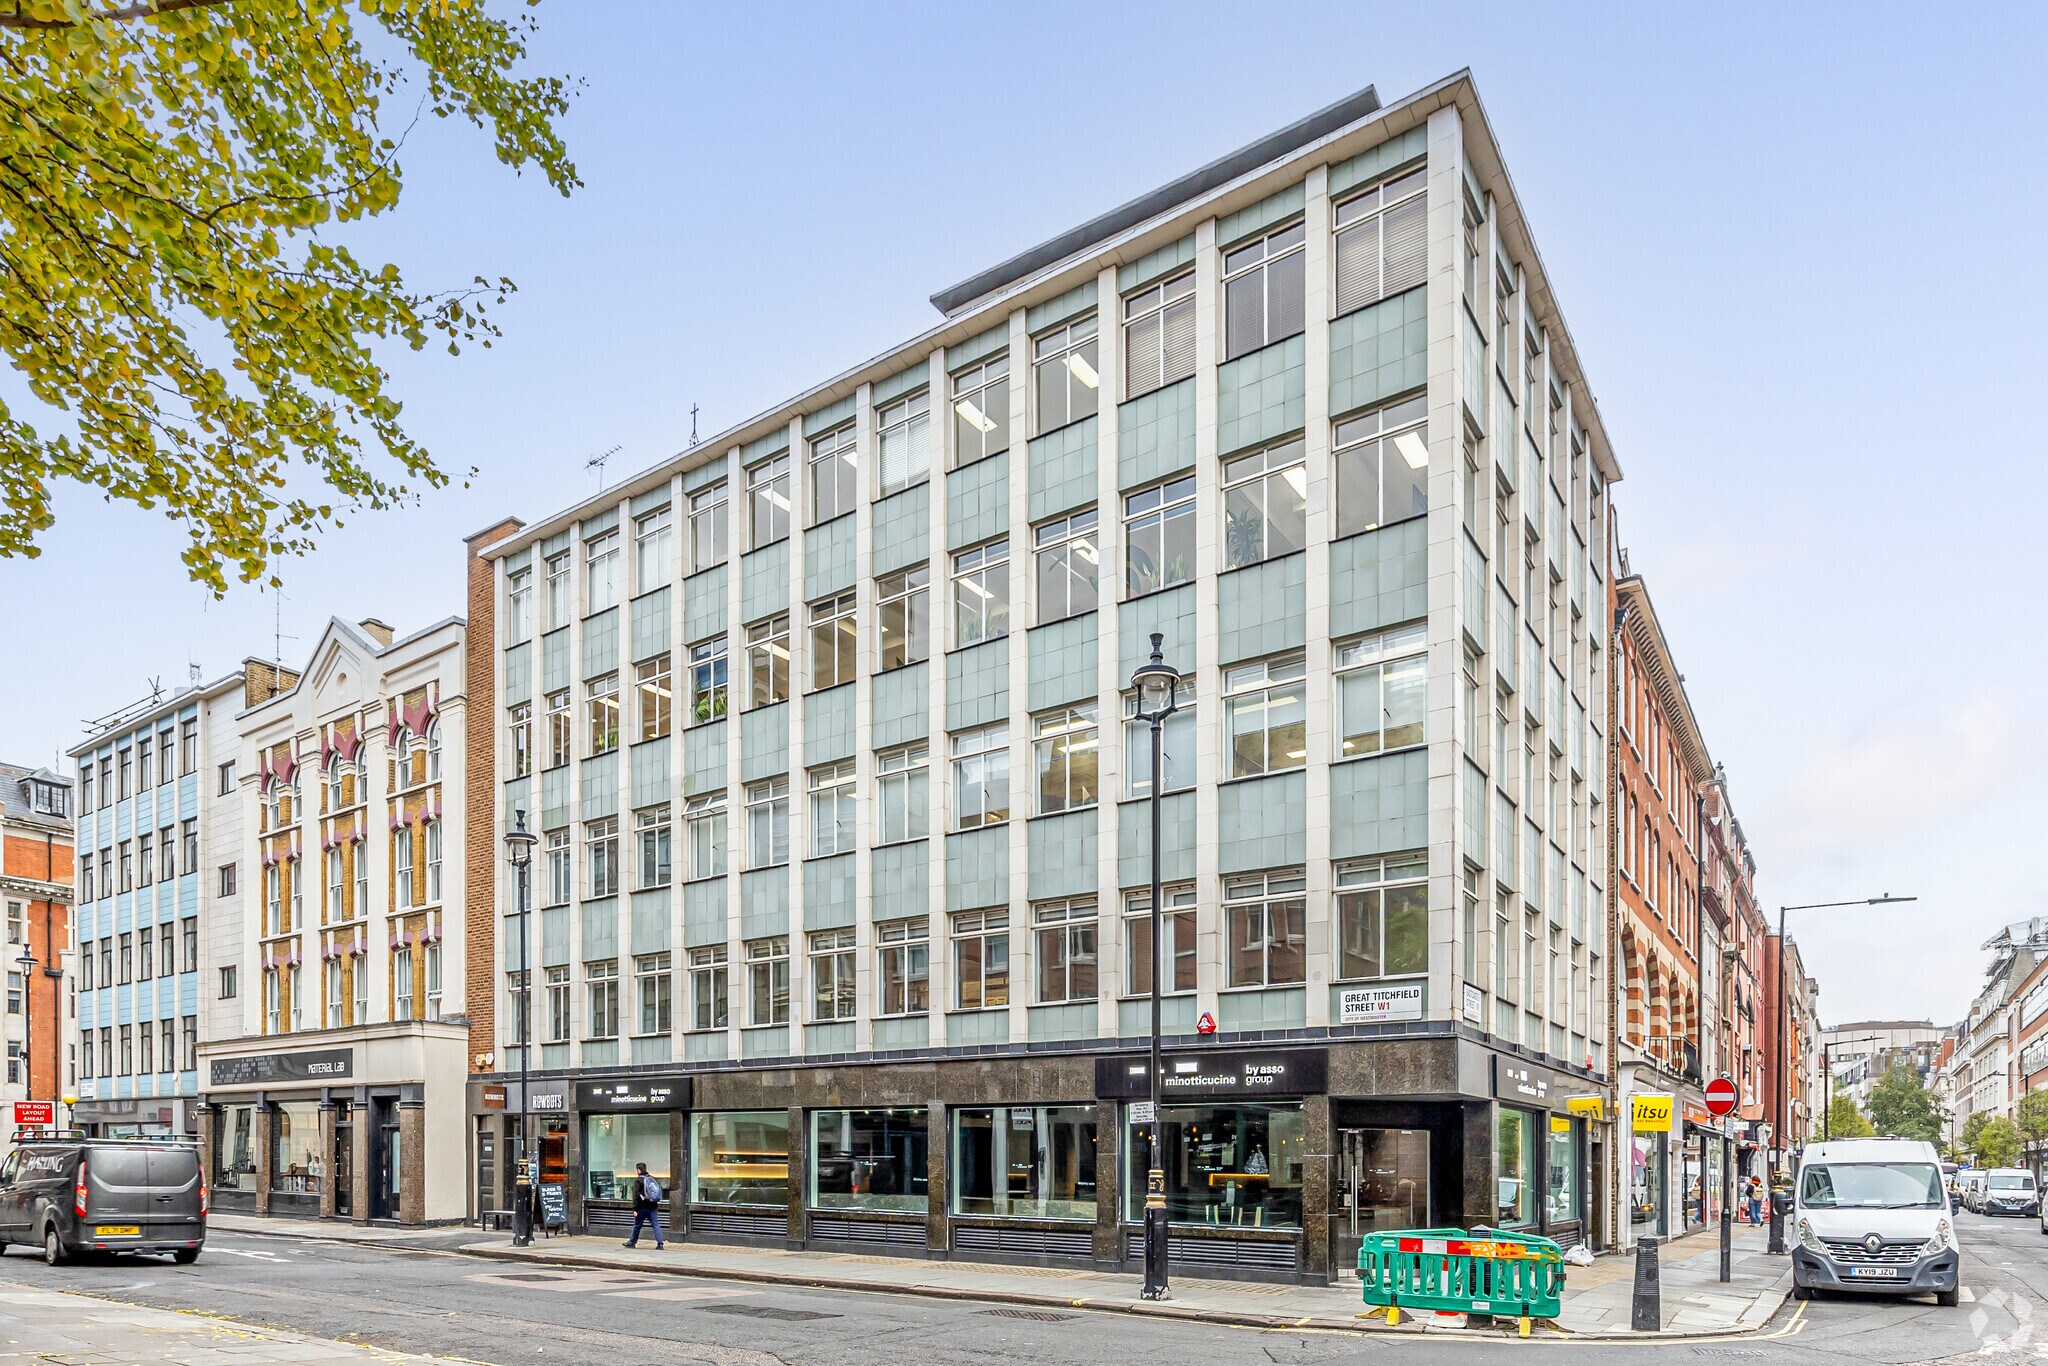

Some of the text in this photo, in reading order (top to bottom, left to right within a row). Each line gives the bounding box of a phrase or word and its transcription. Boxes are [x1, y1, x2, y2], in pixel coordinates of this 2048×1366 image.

[1345, 989, 1419, 1003] GREAT TITCHFIELD
[1345, 1001, 1390, 1013] STREET W1
[1246, 1063, 1284, 1076] by asso
[1165, 1074, 1273, 1086] minotticucine group
[650, 1087, 658, 1096] by
[532, 1094, 562, 1109] ROWBOTS
[650, 1095, 666, 1103] group
[1637, 1104, 1669, 1119] itsu
[1878, 1268, 1894, 1276] JZU
